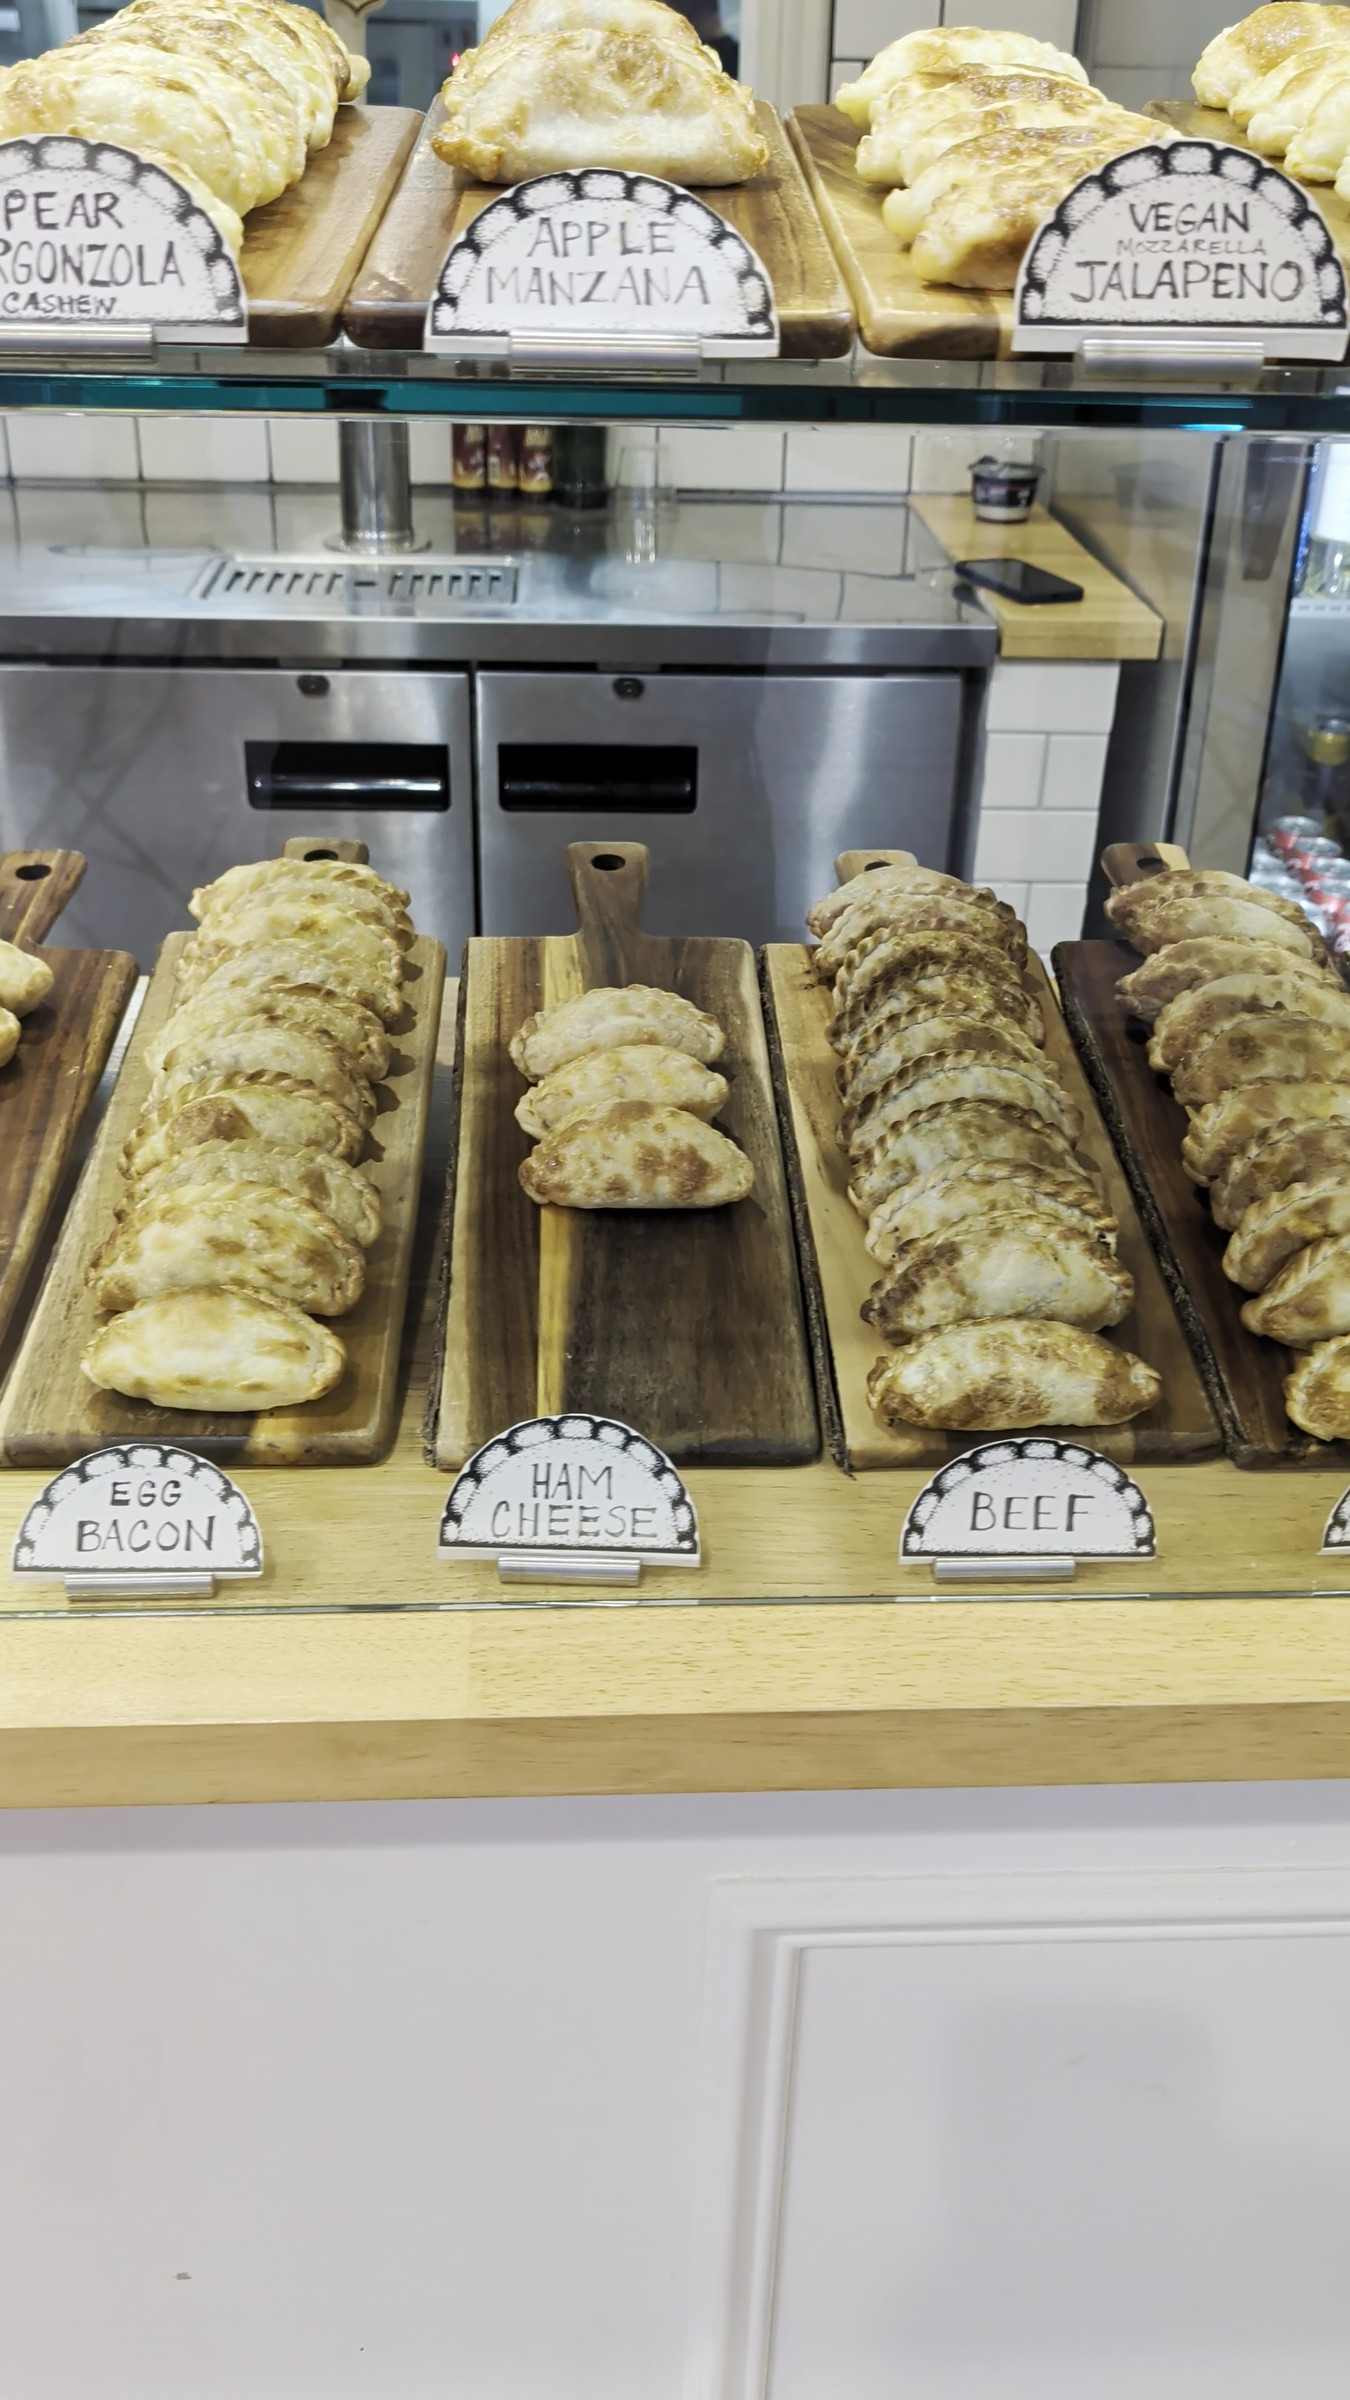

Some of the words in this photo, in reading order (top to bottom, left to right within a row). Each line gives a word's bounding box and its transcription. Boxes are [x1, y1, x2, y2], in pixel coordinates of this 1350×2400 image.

[4, 189, 124, 231] PEAR
[1129, 202, 1250, 235] VEGAN
[526, 217, 676, 258] APPLE
[1116, 238, 1268, 256] MOZZARELLA
[486, 266, 711, 306] MANZANA
[1069, 259, 1304, 302] JALAPENO
[110, 1480, 182, 1507] EGG
[532, 1462, 613, 1500] HAM
[491, 1501, 657, 1538] CHEESE
[969, 1491, 1095, 1532] BEEF
[77, 1515, 216, 1552] BACON
